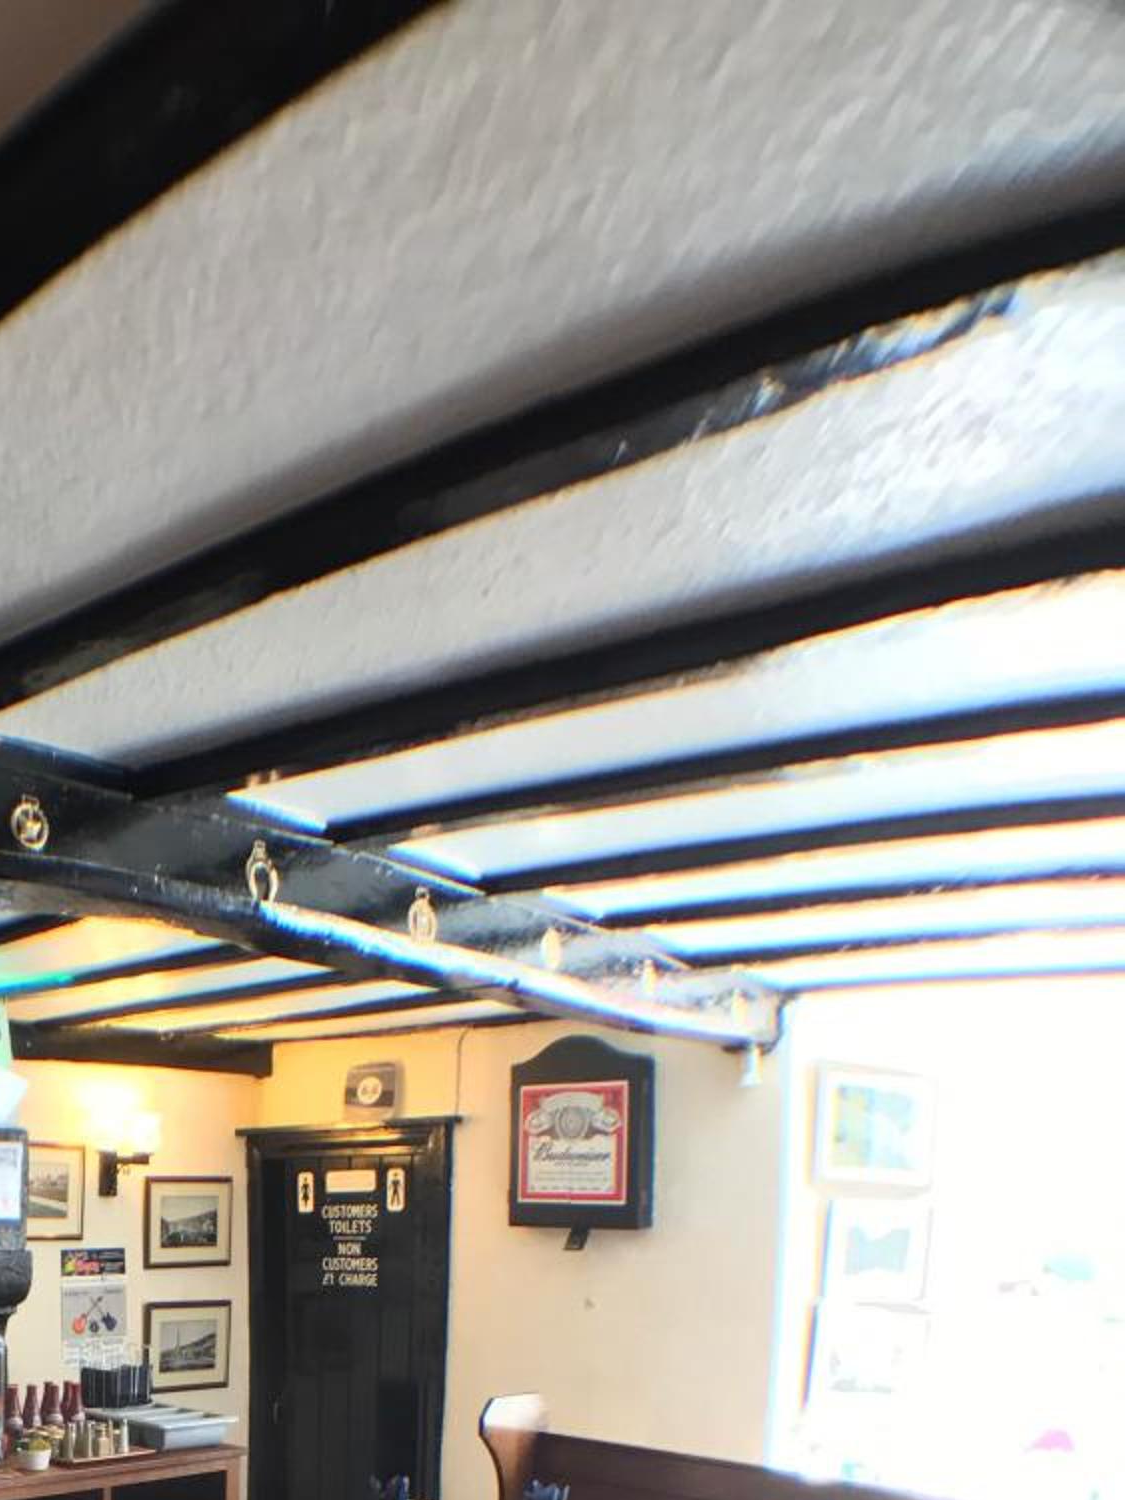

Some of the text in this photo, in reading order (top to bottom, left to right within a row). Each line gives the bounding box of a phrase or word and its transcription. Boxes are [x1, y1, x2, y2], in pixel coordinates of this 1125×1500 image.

[321, 1204, 378, 1219] CUSTOMERS
[329, 1220, 372, 1234] TOILETS
[338, 1242, 362, 1256] NON
[322, 1257, 378, 1271] CUSTOMERS
[338, 1272, 378, 1287] CHARGE
